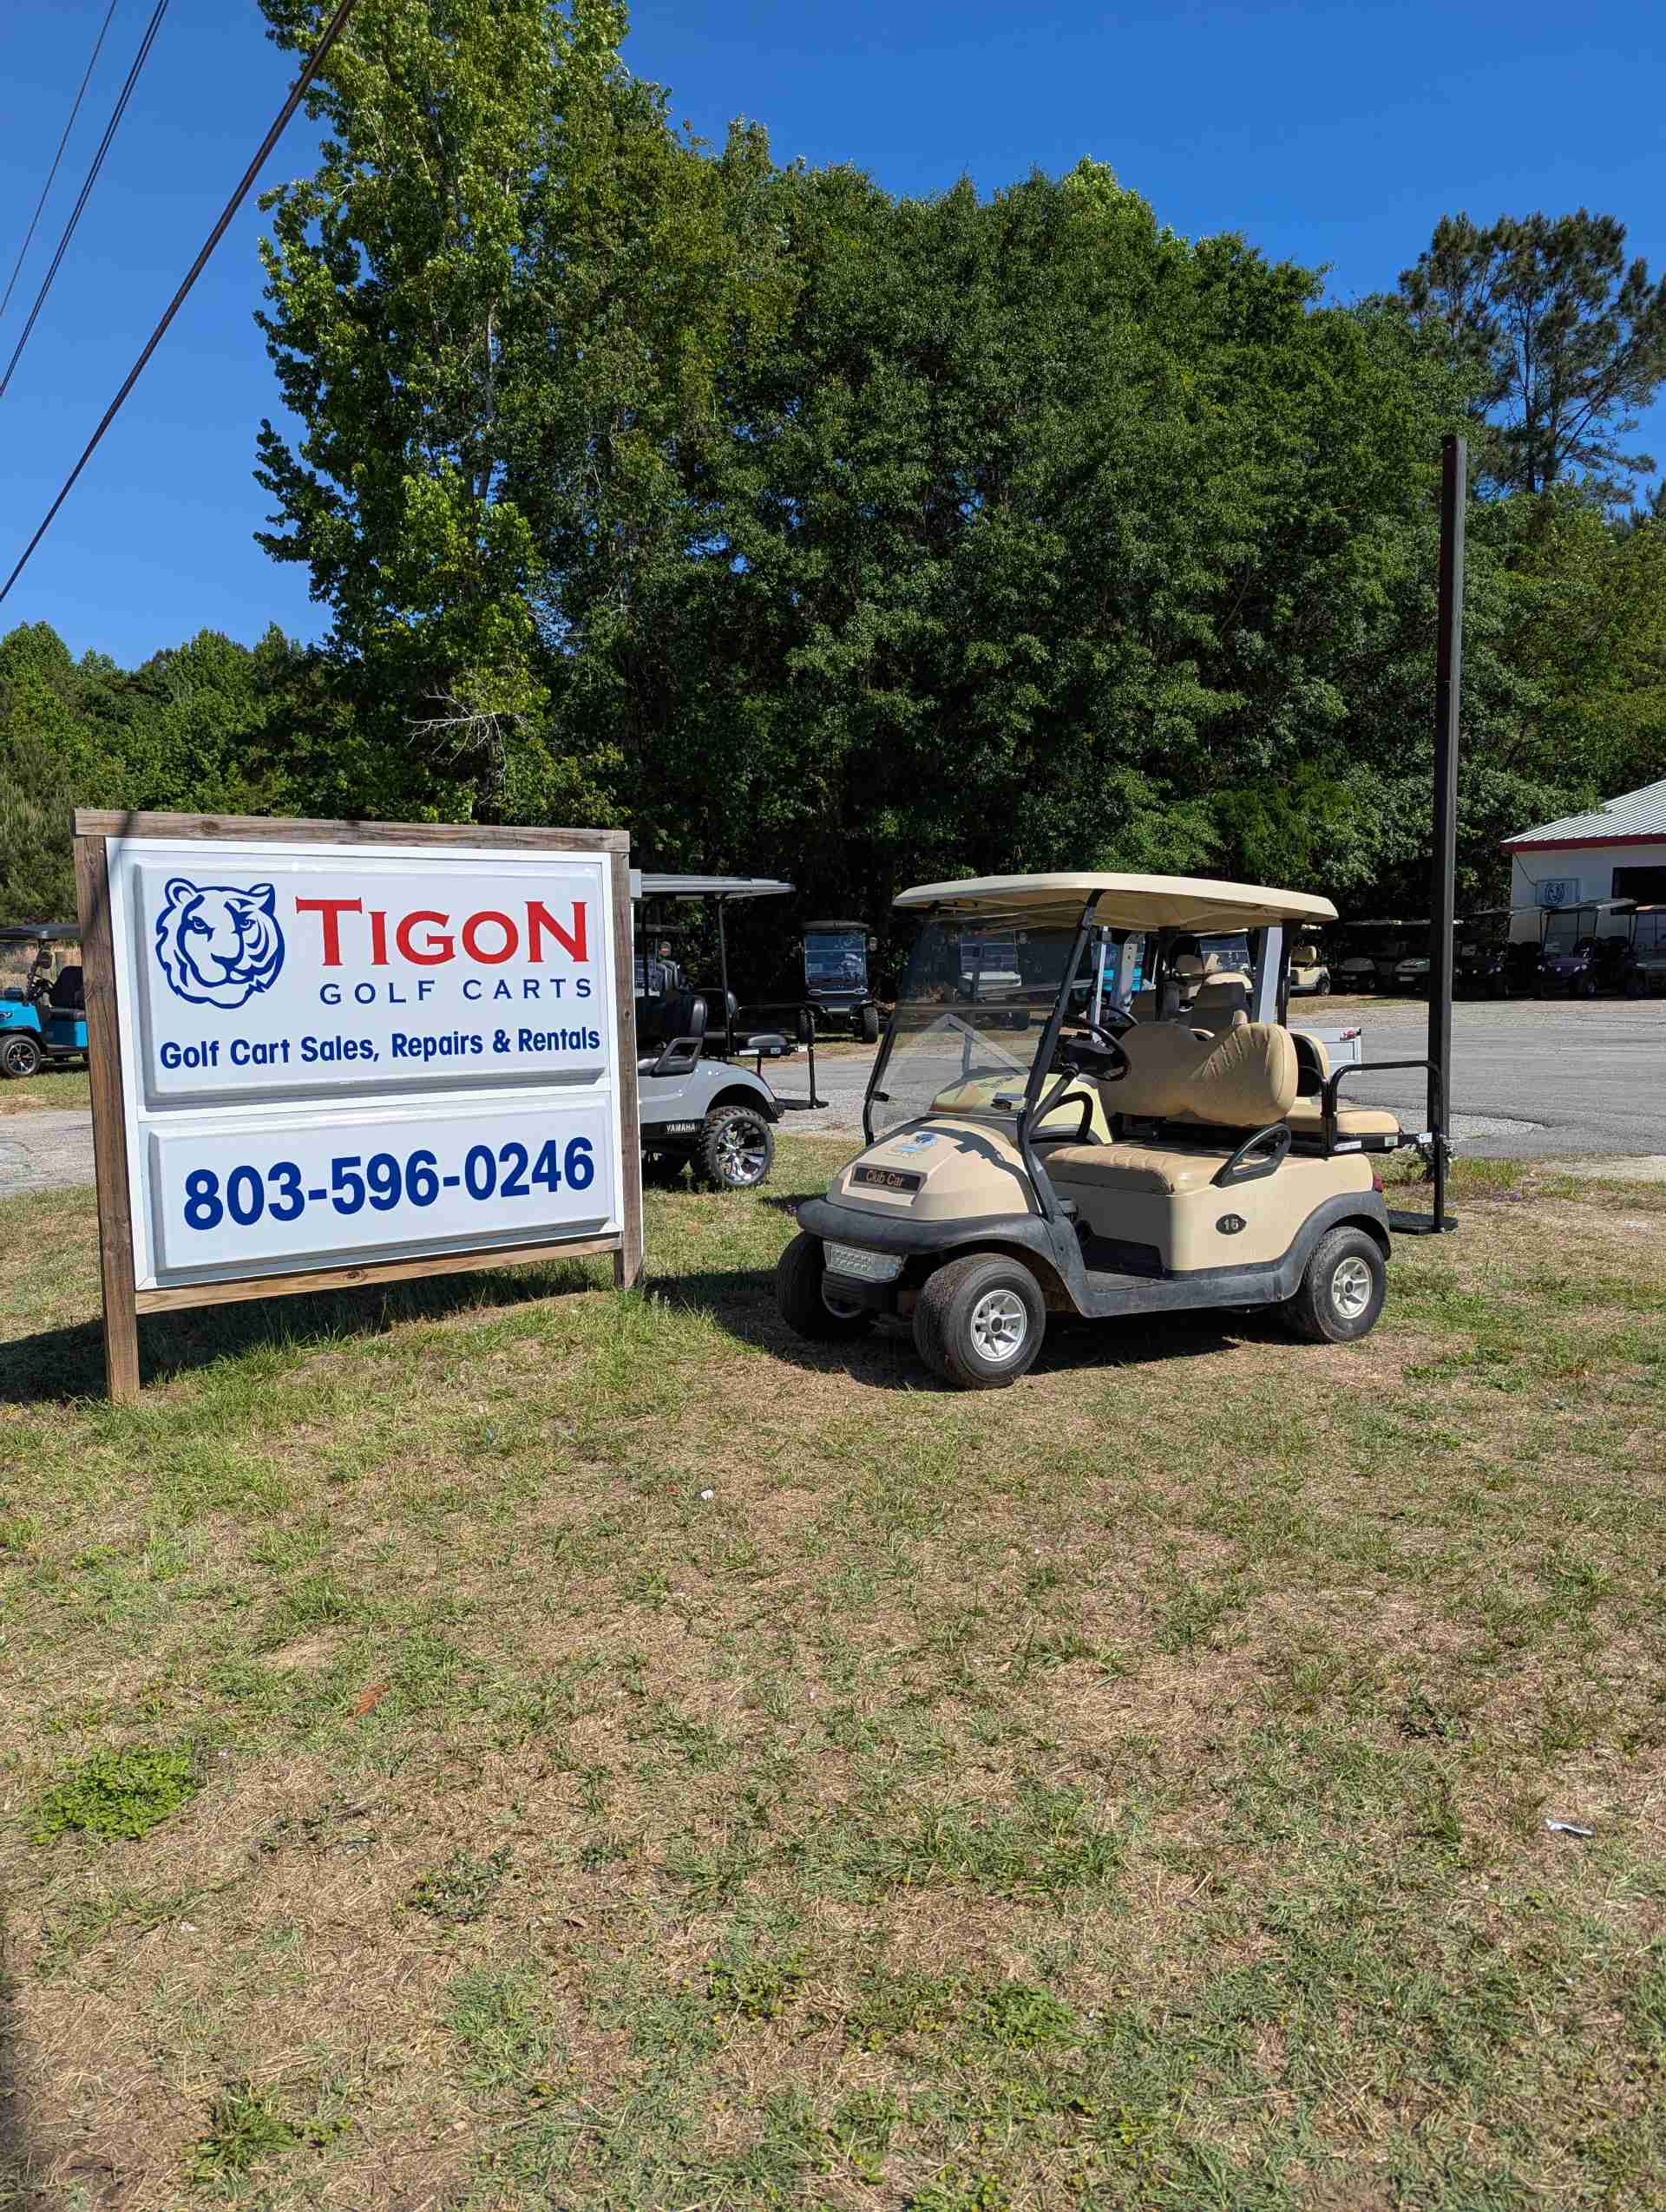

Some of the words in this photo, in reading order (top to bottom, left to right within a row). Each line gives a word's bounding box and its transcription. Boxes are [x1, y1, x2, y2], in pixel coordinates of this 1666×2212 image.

[319, 981, 436, 1005] GOLF
[462, 978, 592, 1000] CARTS
[160, 1040, 220, 1070] Golf
[230, 1037, 291, 1066] Cart
[300, 1034, 380, 1063] Sales,
[391, 1031, 484, 1062] Repairs
[492, 1029, 511, 1054] &
[518, 1026, 600, 1052] Rentals
[666, 1123, 696, 1133] YAMAHA
[183, 1136, 595, 1231] 803-596-0246
[866, 1169, 885, 1183] Club
[887, 1173, 903, 1187] Car
